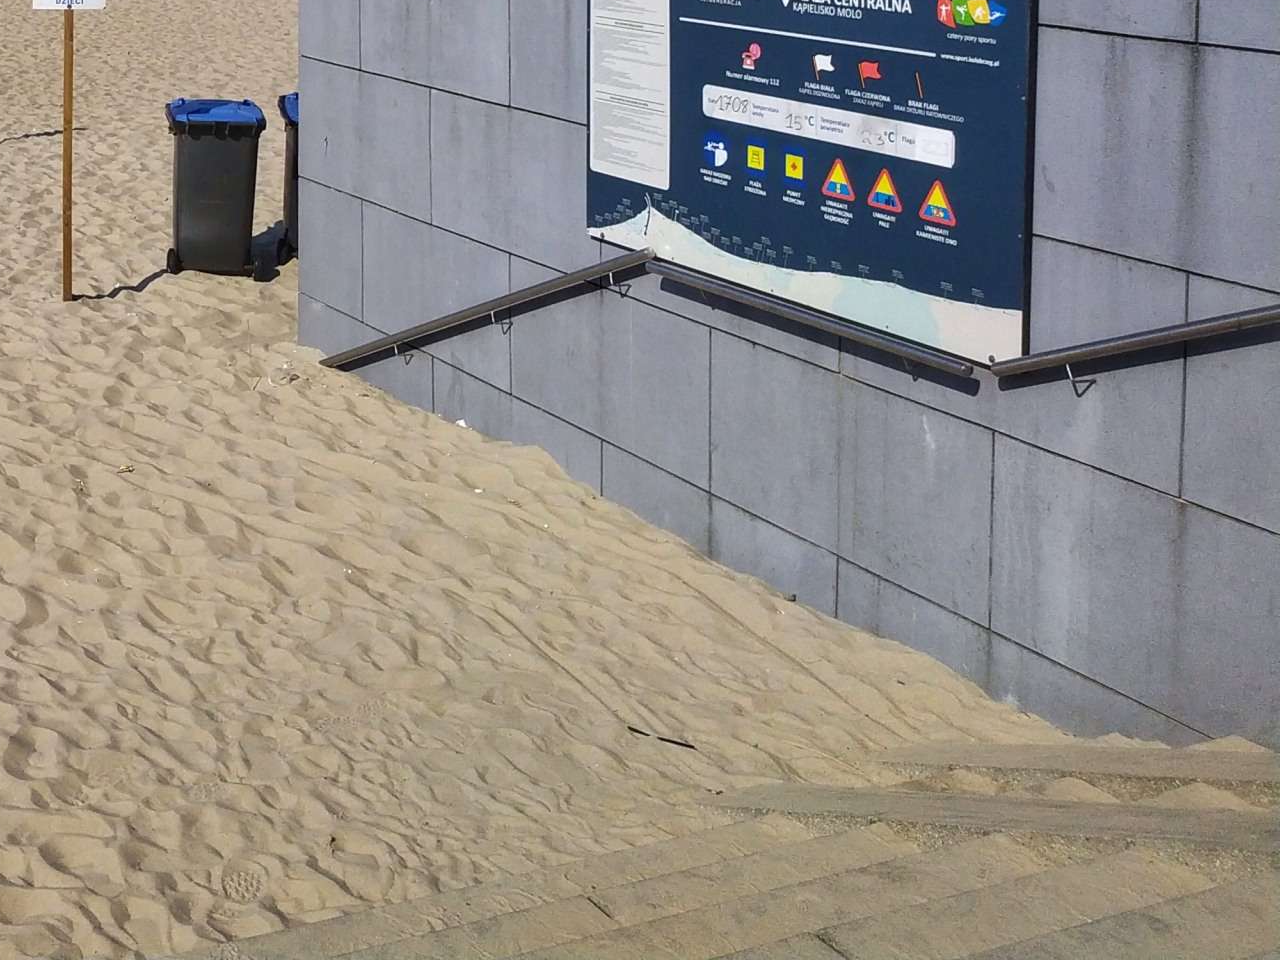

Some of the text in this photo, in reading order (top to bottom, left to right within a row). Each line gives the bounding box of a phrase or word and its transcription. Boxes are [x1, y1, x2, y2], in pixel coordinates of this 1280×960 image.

[792, 2, 862, 20] KĄPIELISKO MOLO
[770, 78, 780, 87] 112
